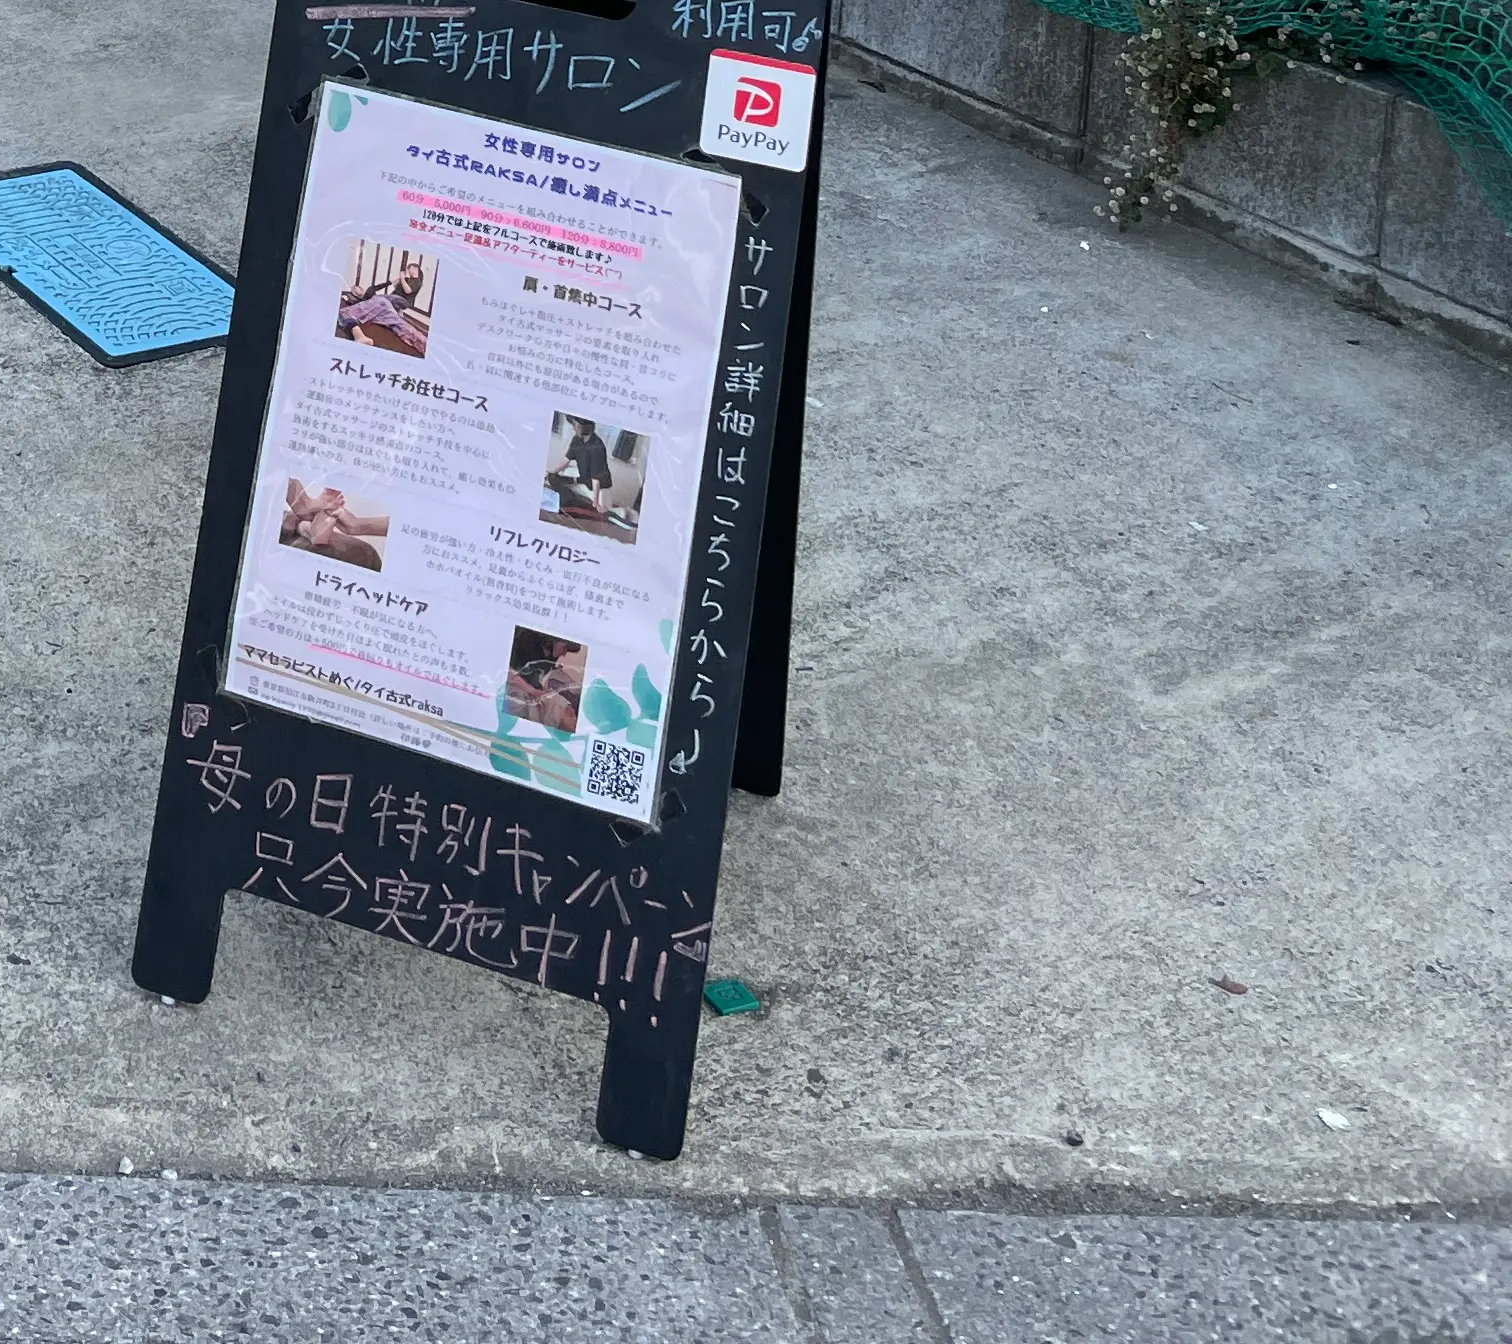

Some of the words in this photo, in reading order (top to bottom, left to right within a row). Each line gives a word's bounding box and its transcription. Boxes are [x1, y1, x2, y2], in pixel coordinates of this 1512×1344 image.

[323, 15, 682, 113] 女性専用サロン
[483, 131, 601, 174] 女性専用サロン
[718, 123, 790, 156] PayPay
[521, 274, 645, 320] 肩・首集中コース
[328, 355, 490, 413] ストレッチお任せコース
[689, 236, 773, 718] サロン詳細はこちらから
[488, 524, 602, 571] リフレクソロジー
[313, 569, 430, 620] ドライヘッドケア
